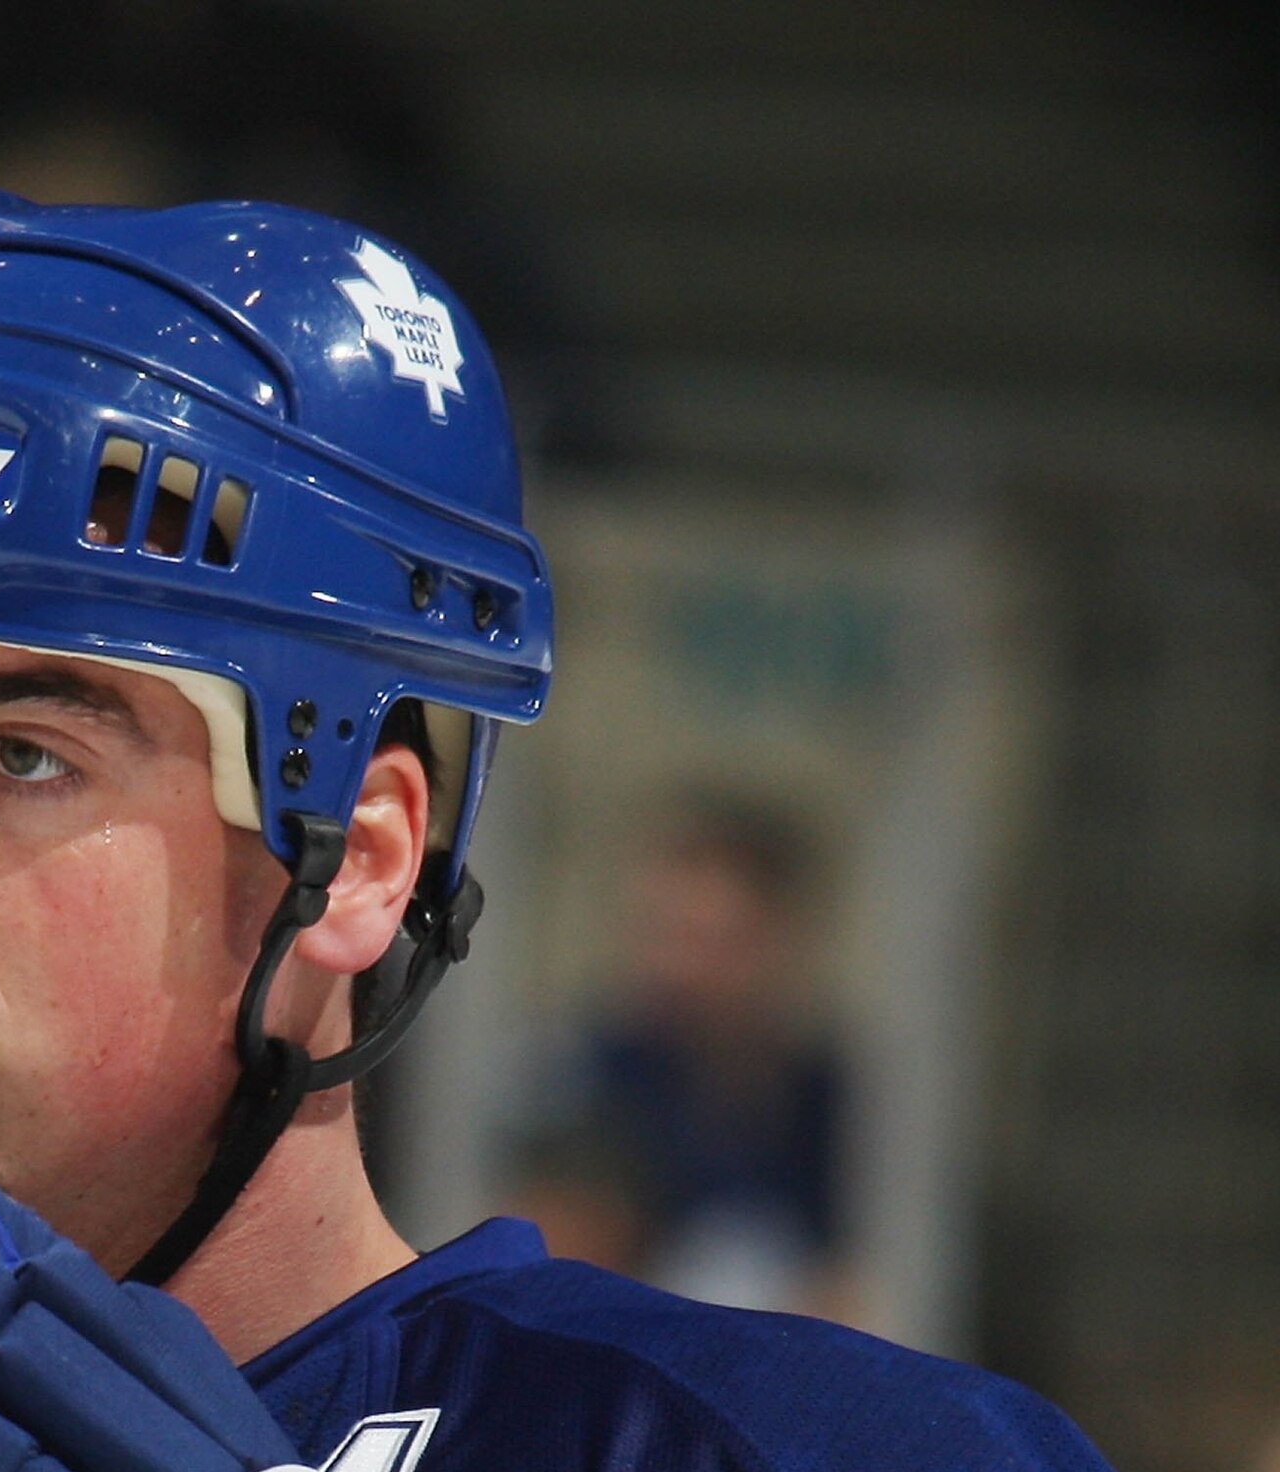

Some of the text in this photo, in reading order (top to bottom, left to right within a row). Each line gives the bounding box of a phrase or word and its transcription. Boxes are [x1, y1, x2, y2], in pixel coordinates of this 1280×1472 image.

[375, 304, 441, 333] TORONTO
[394, 325, 439, 350] MAPLE
[405, 346, 444, 371] LEAFS
